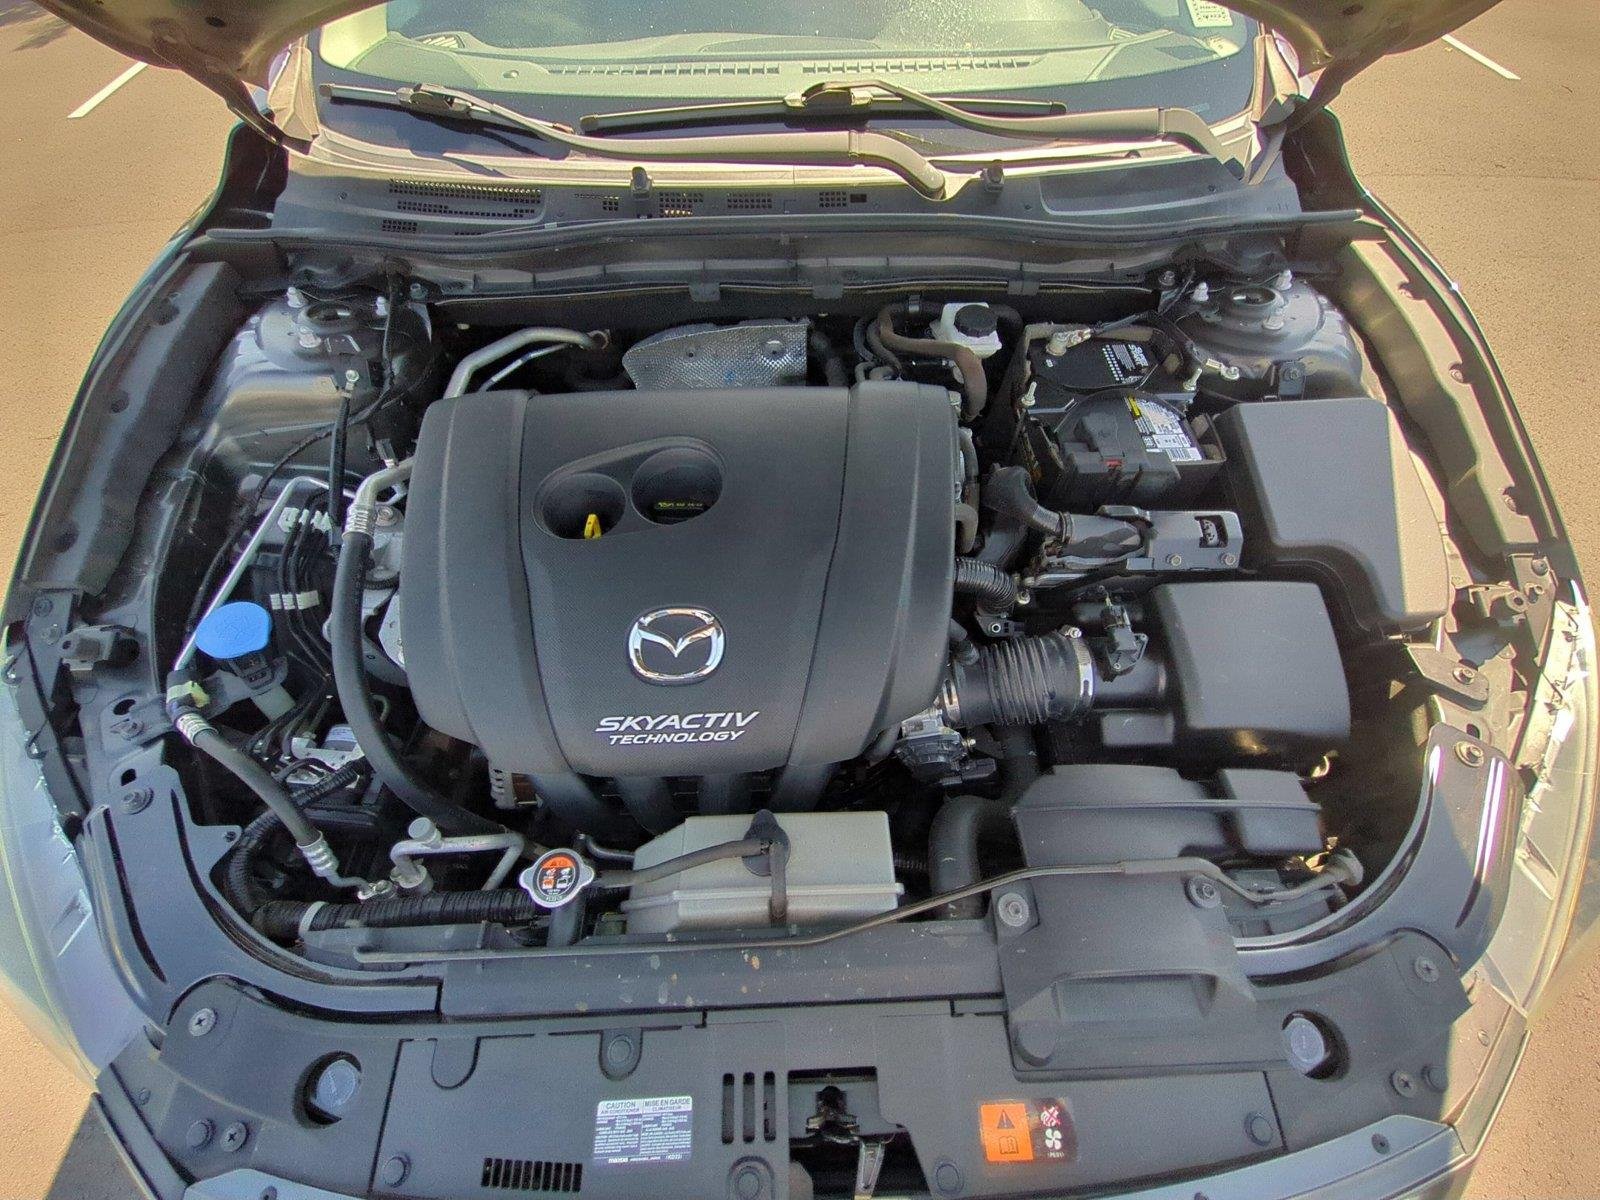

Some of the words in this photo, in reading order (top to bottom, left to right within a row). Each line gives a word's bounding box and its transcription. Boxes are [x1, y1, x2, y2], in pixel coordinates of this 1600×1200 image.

[595, 711, 760, 732] SKYACTIV
[609, 730, 745, 745] TECHNOLOGY
[605, 1101, 636, 1110] CAUTION
[644, 1099, 660, 1107] MISE
[669, 1098, 691, 1106] GARDE
